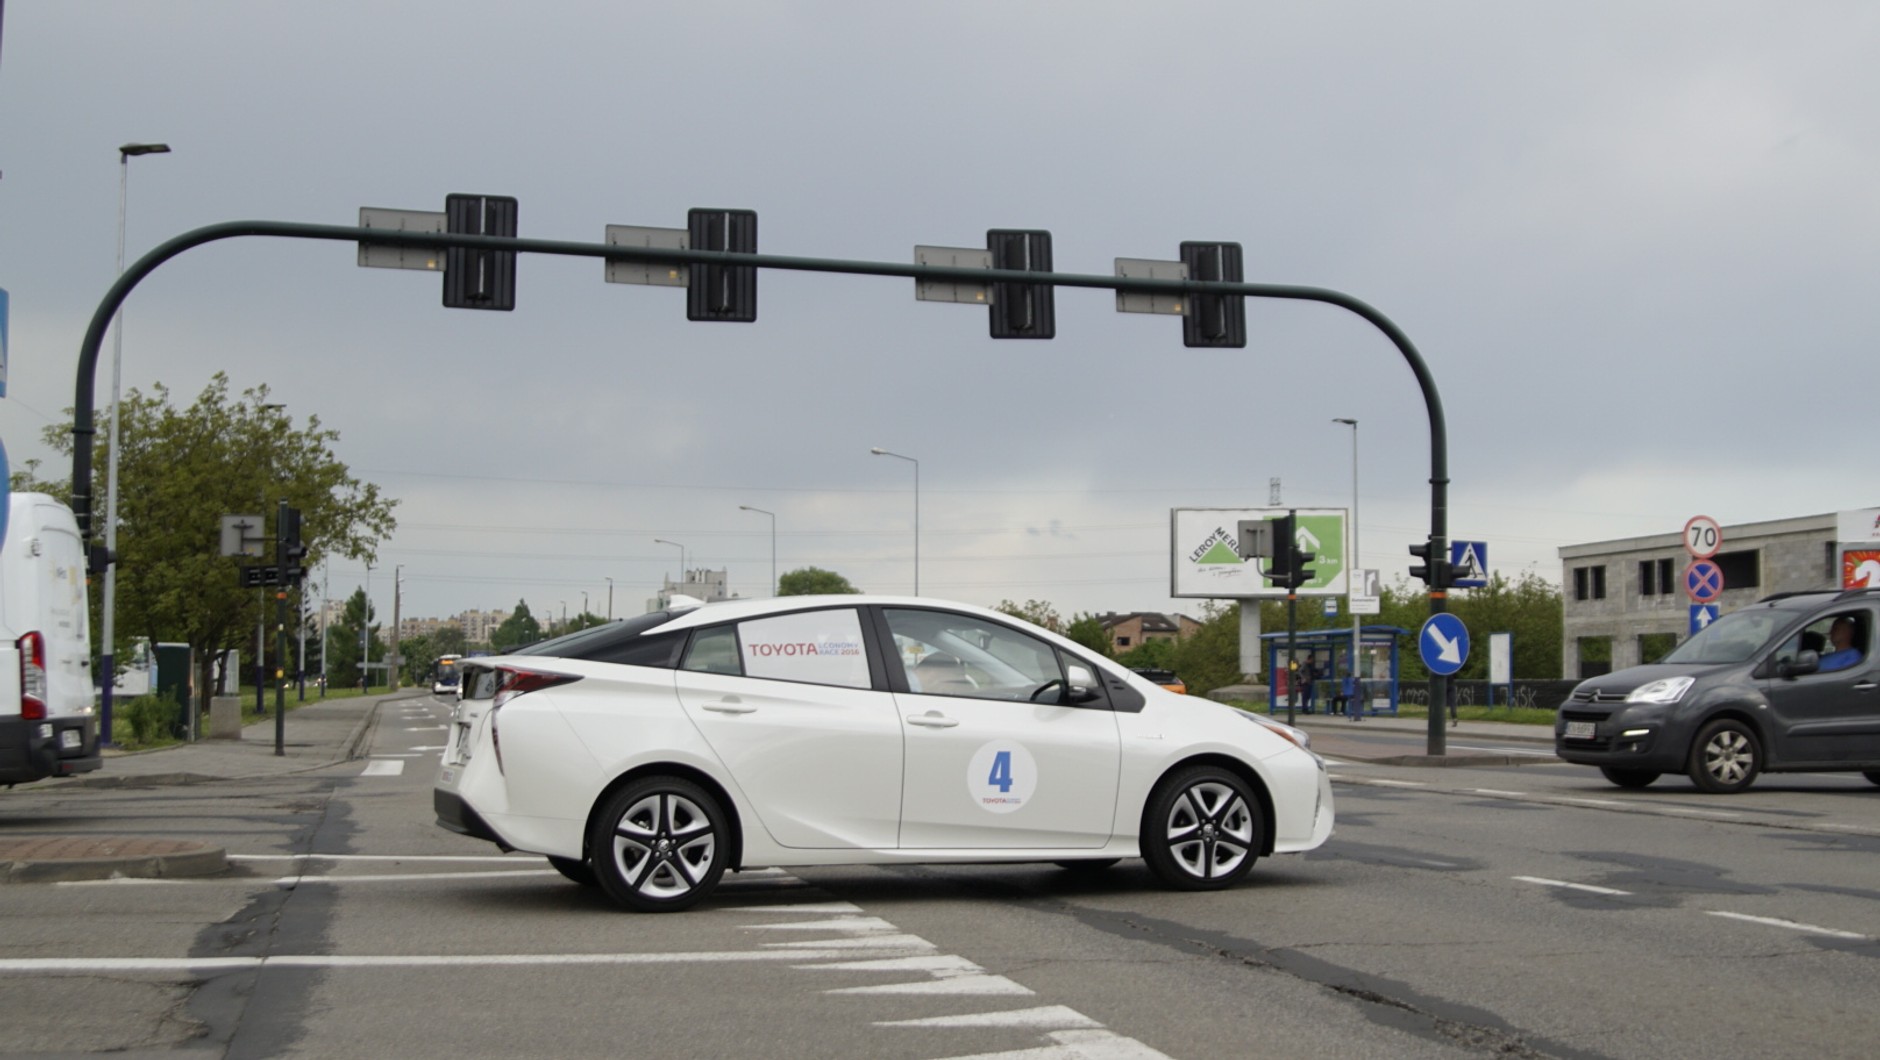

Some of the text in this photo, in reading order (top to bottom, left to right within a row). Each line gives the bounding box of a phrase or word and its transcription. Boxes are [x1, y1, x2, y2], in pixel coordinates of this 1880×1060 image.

[1691, 526, 1717, 547] 70
[1189, 532, 1218, 563] LEROY
[1319, 555, 1338, 565] 3 km
[748, 642, 818, 657] TOYOTA
[840, 648, 860, 656] 2016
[988, 750, 1013, 793] 4
